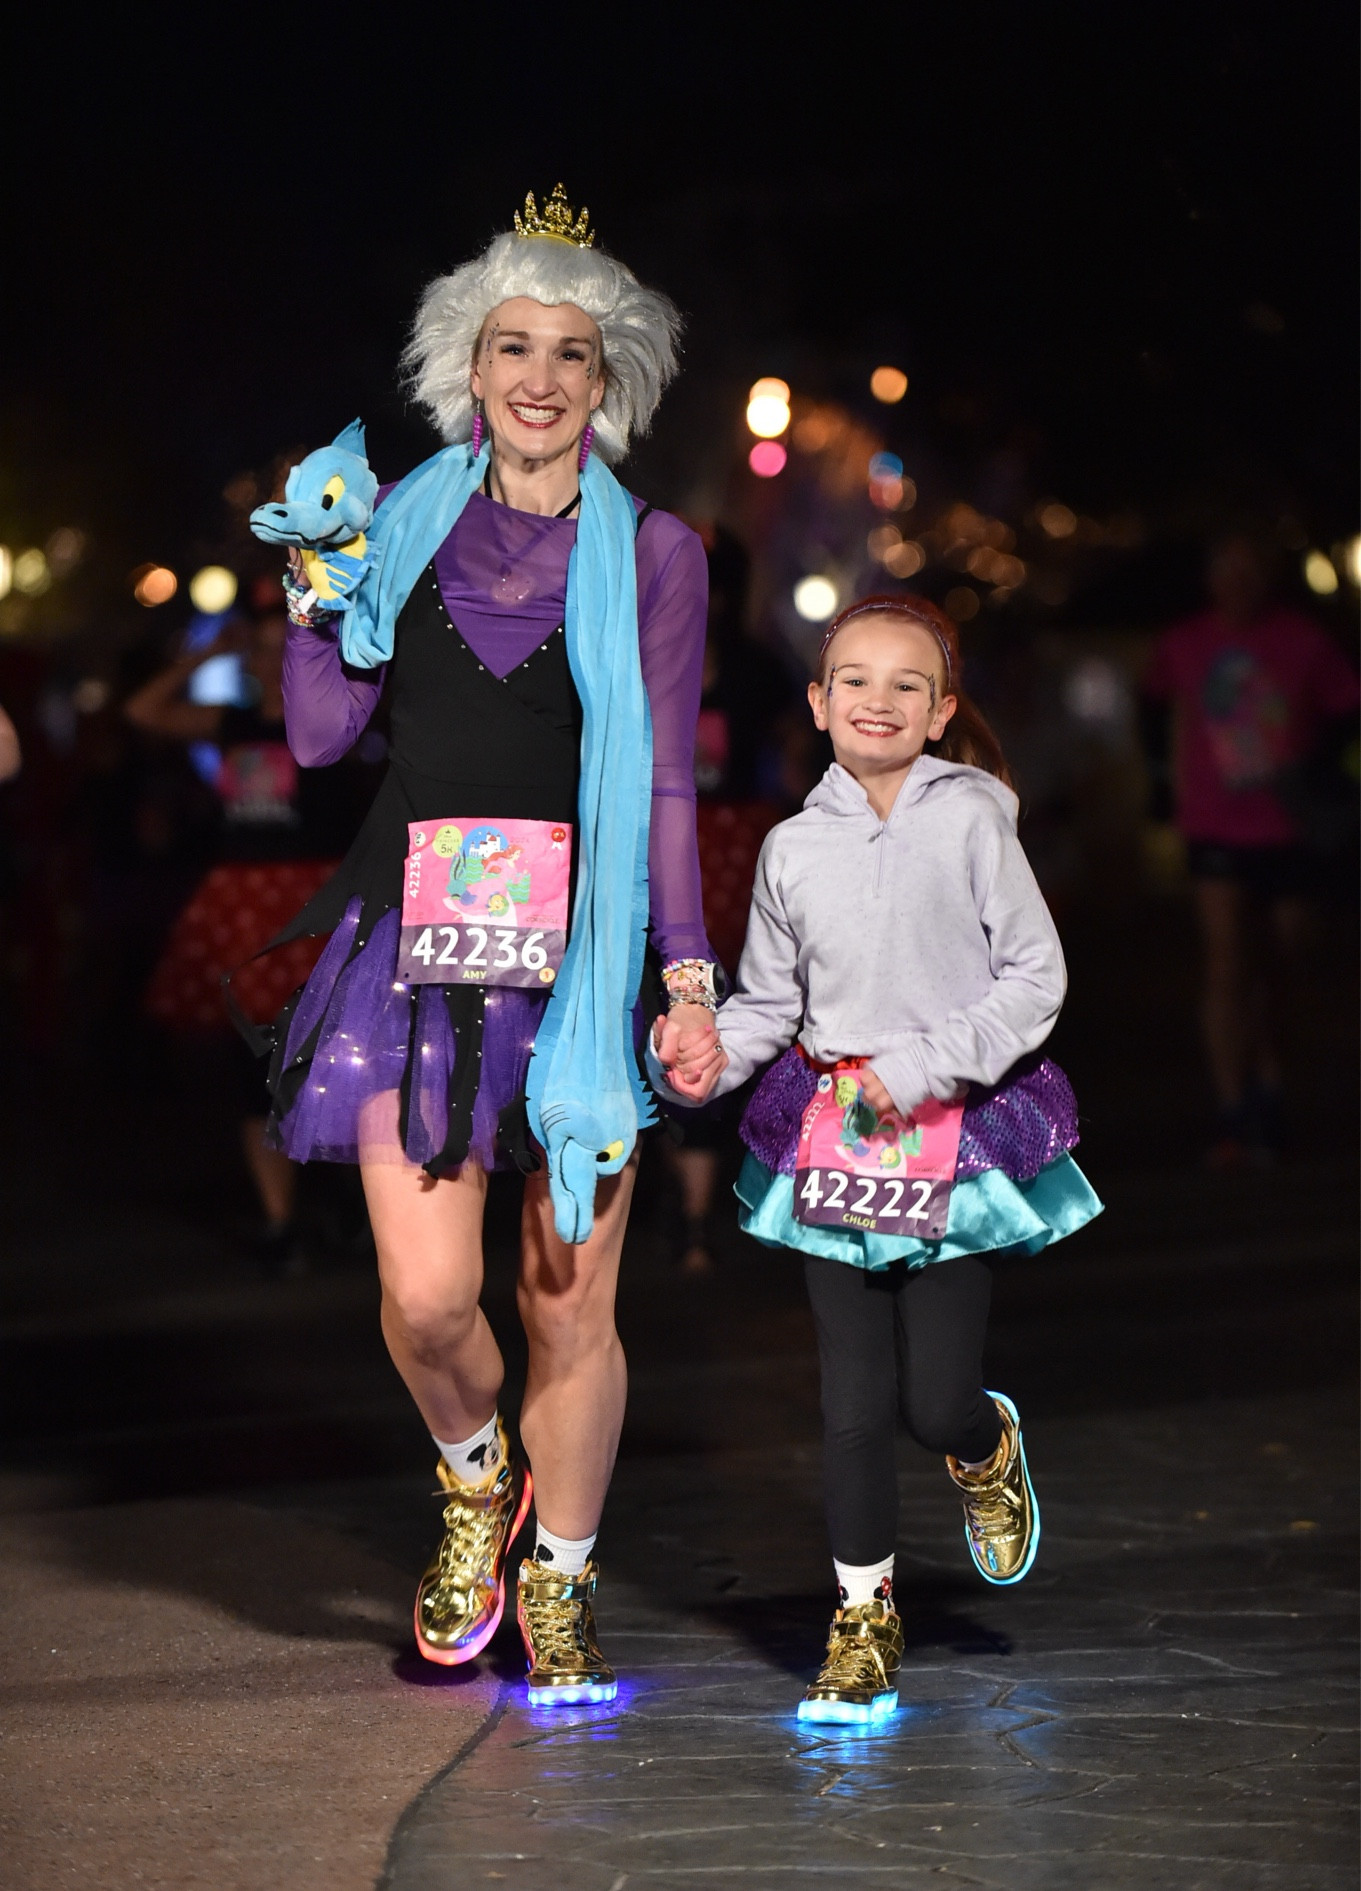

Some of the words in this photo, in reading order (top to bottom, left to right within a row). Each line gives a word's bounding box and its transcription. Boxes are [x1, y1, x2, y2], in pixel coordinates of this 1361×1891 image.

[409, 852, 422, 898] 42236
[411, 926, 548, 970] 42236
[462, 970, 488, 980] AMY
[802, 1101, 826, 1142] 42222
[800, 1169, 933, 1221] 42222
[842, 1213, 877, 1229] CHLOE
